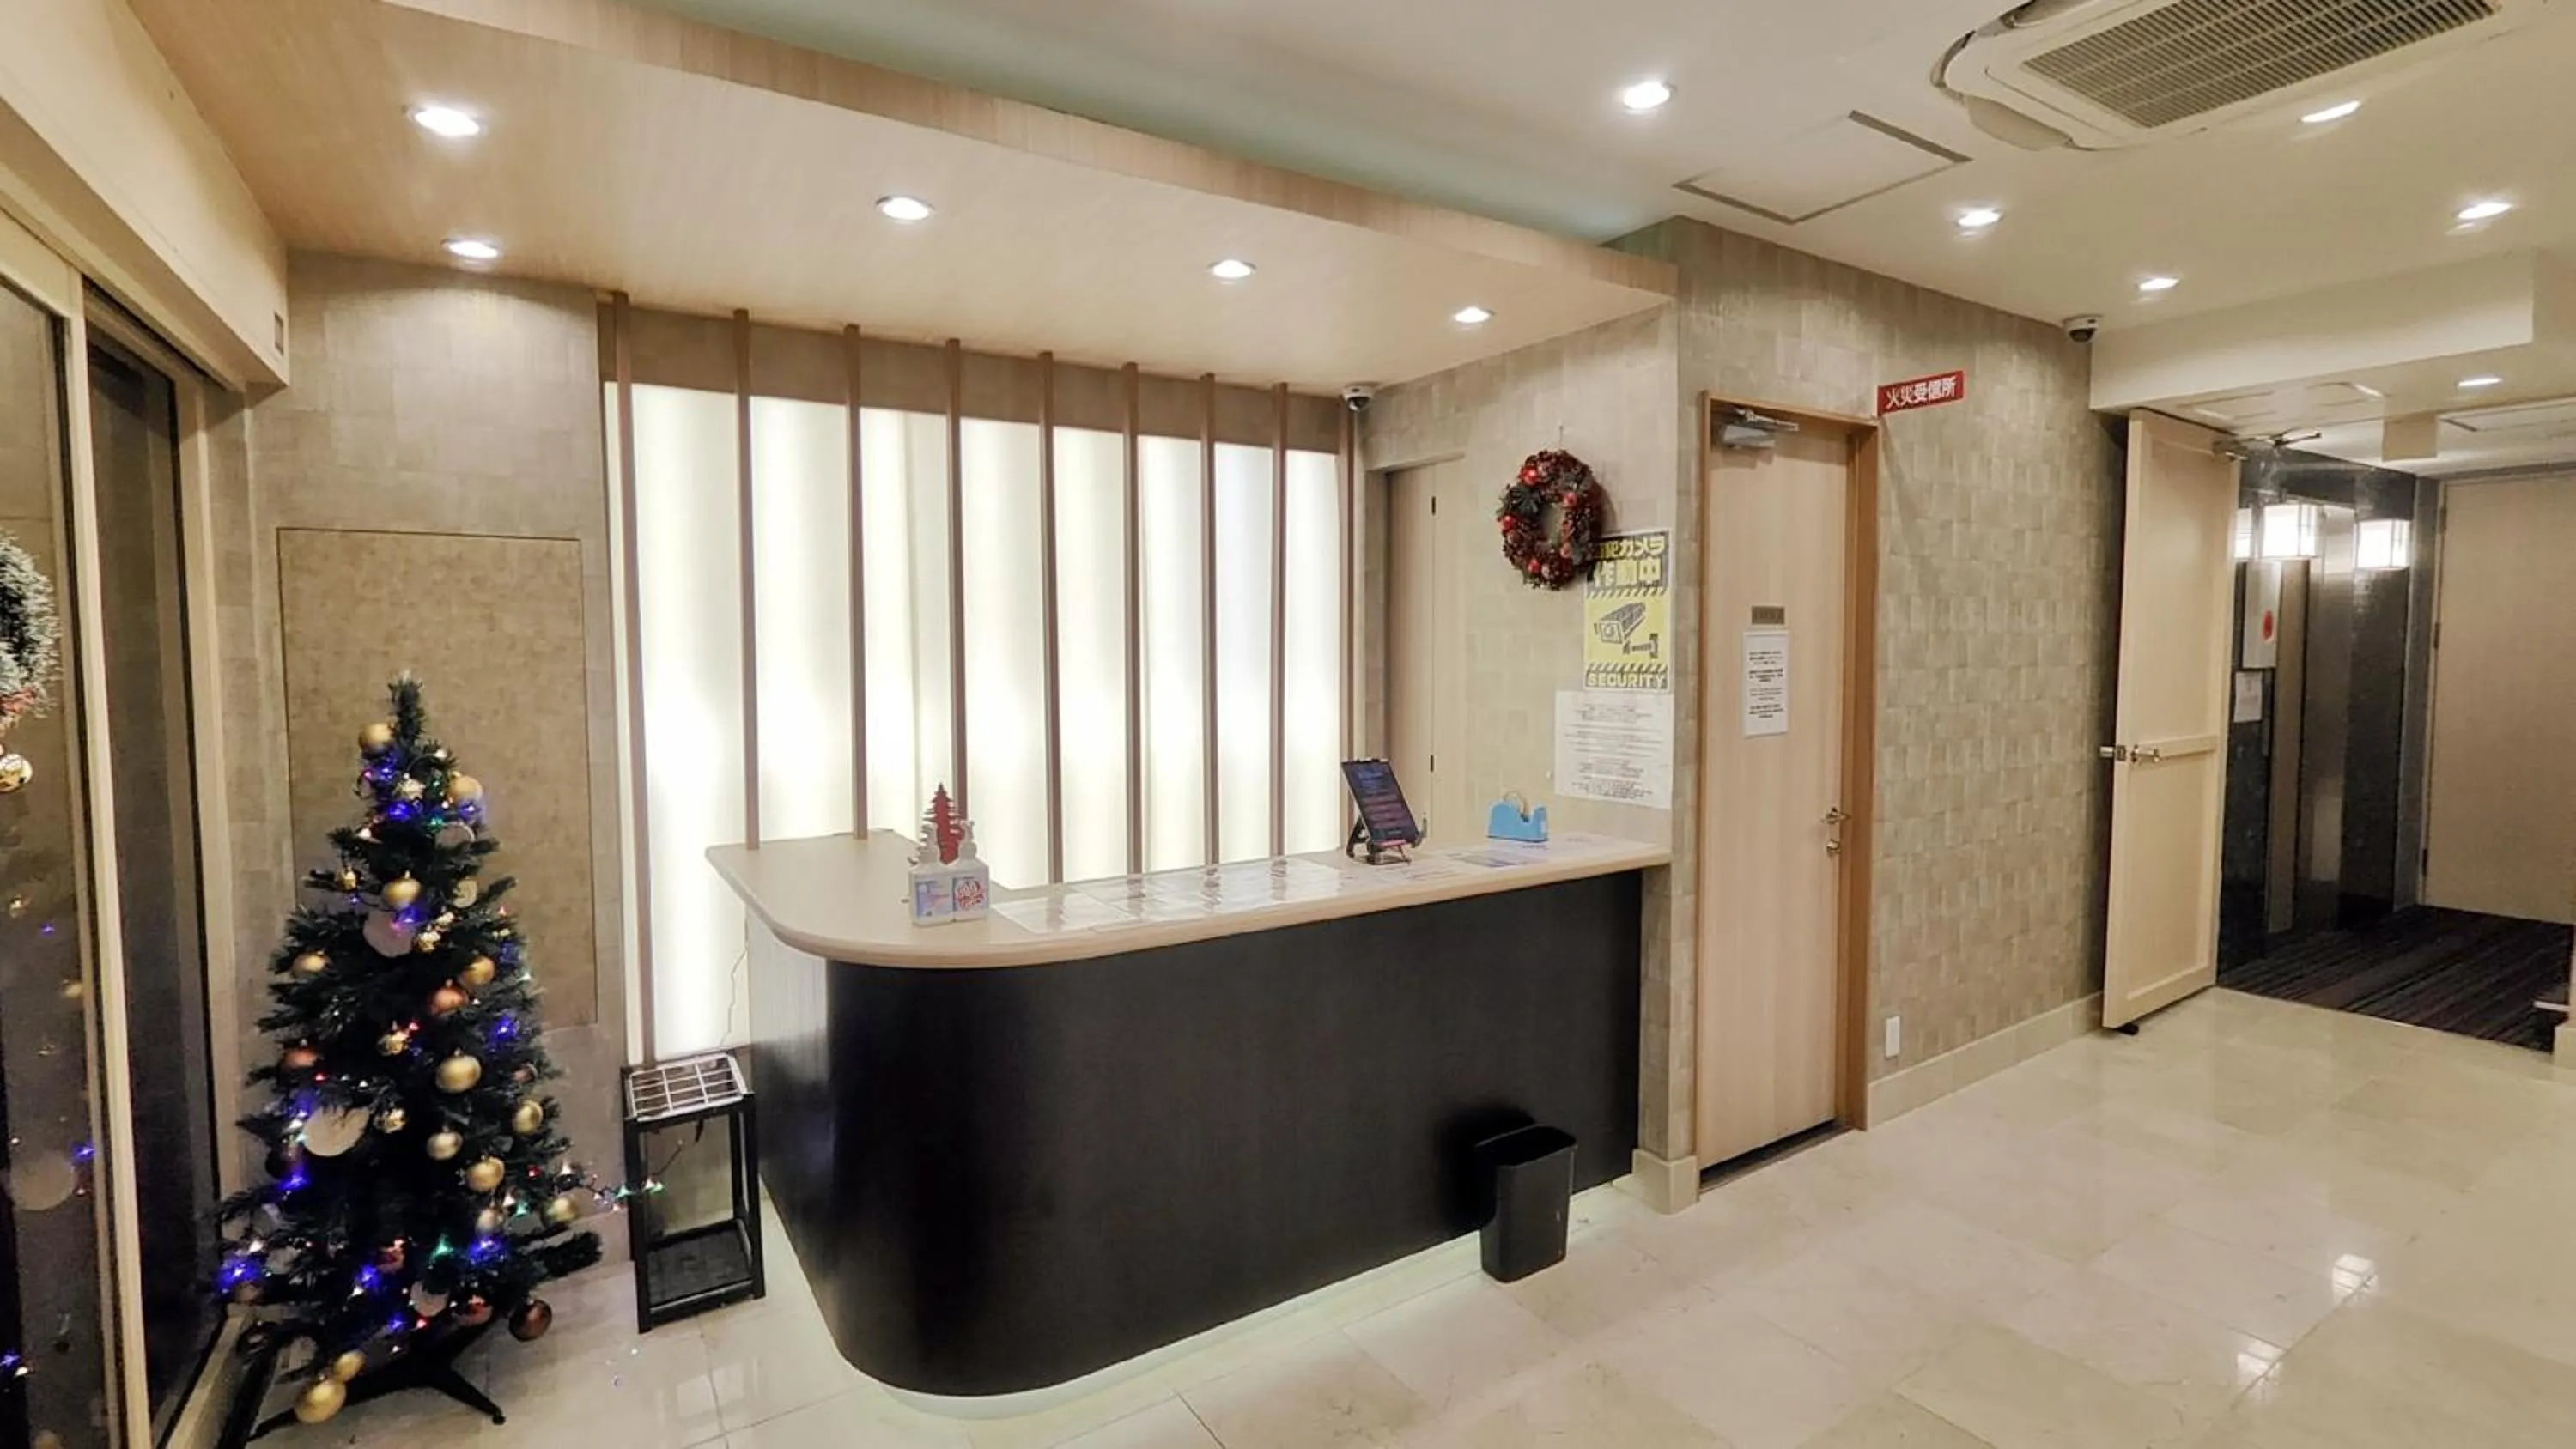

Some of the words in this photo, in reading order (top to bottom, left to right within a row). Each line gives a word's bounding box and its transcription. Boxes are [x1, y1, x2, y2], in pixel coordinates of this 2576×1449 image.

[1885, 375, 1957, 409] 火災受信所
[1597, 535, 1666, 559] 犯カメラ
[1587, 672, 1665, 688] SECURITY
